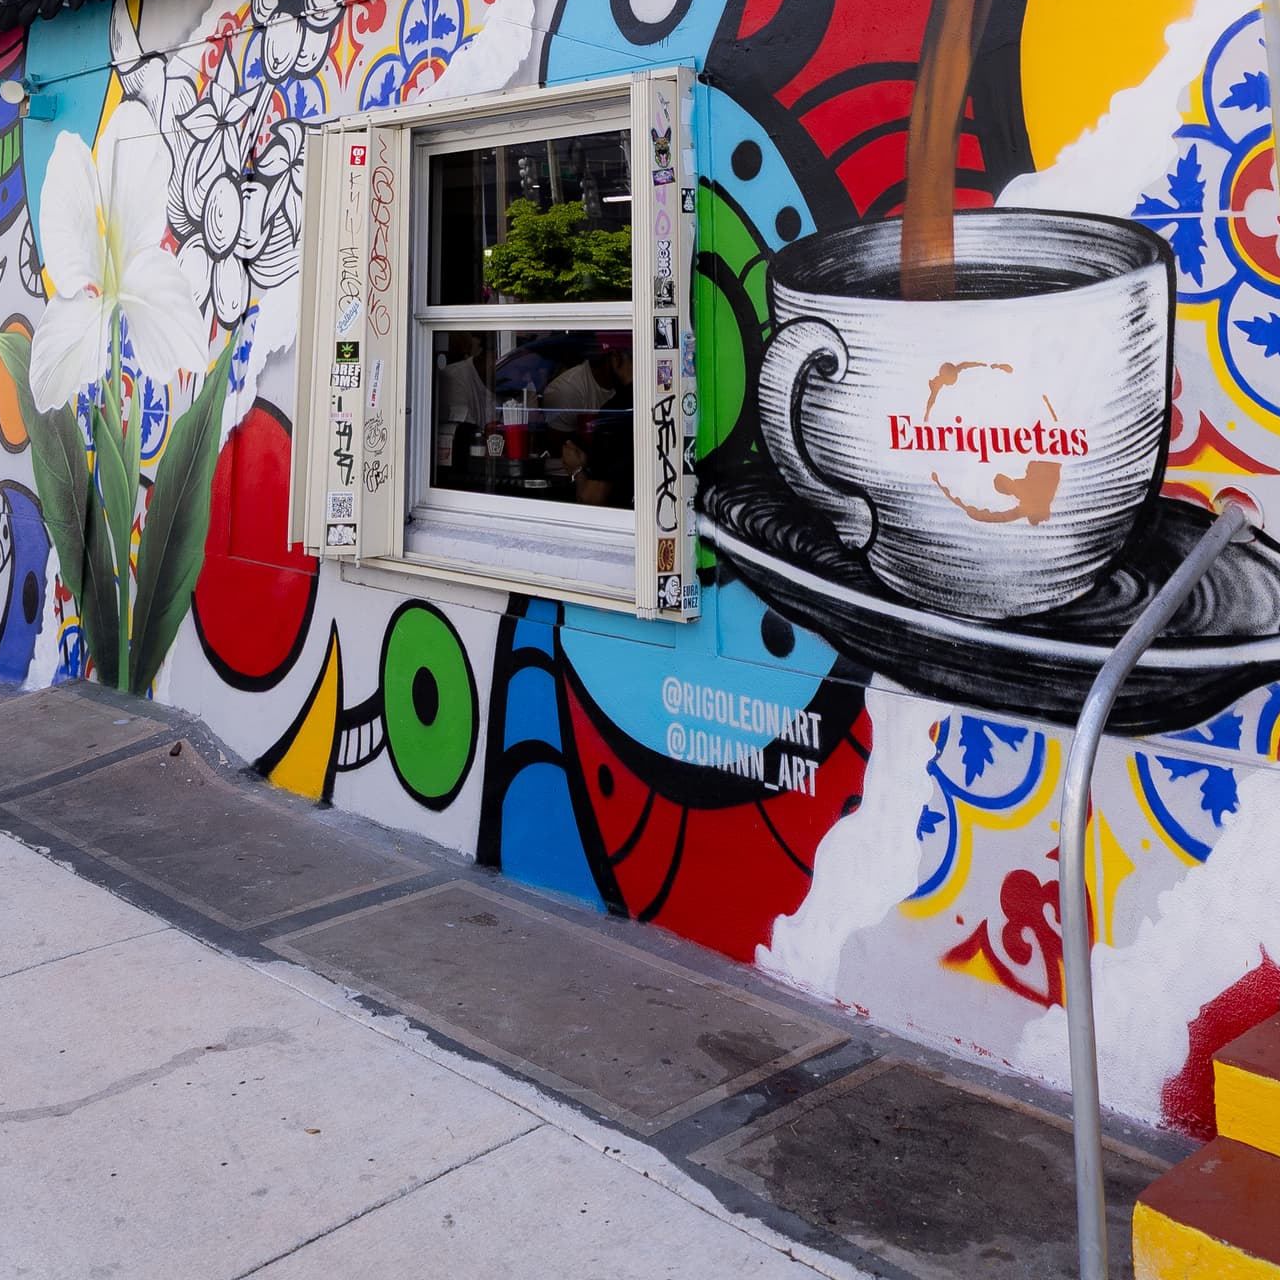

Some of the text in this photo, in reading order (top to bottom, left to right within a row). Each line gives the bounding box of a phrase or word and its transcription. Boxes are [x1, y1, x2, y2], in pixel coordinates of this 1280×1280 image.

[887, 415, 1089, 463] Enriquetas
[662, 676, 822, 750] @RIGOLEONART
[667, 722, 819, 797] @JOHANN_ART
